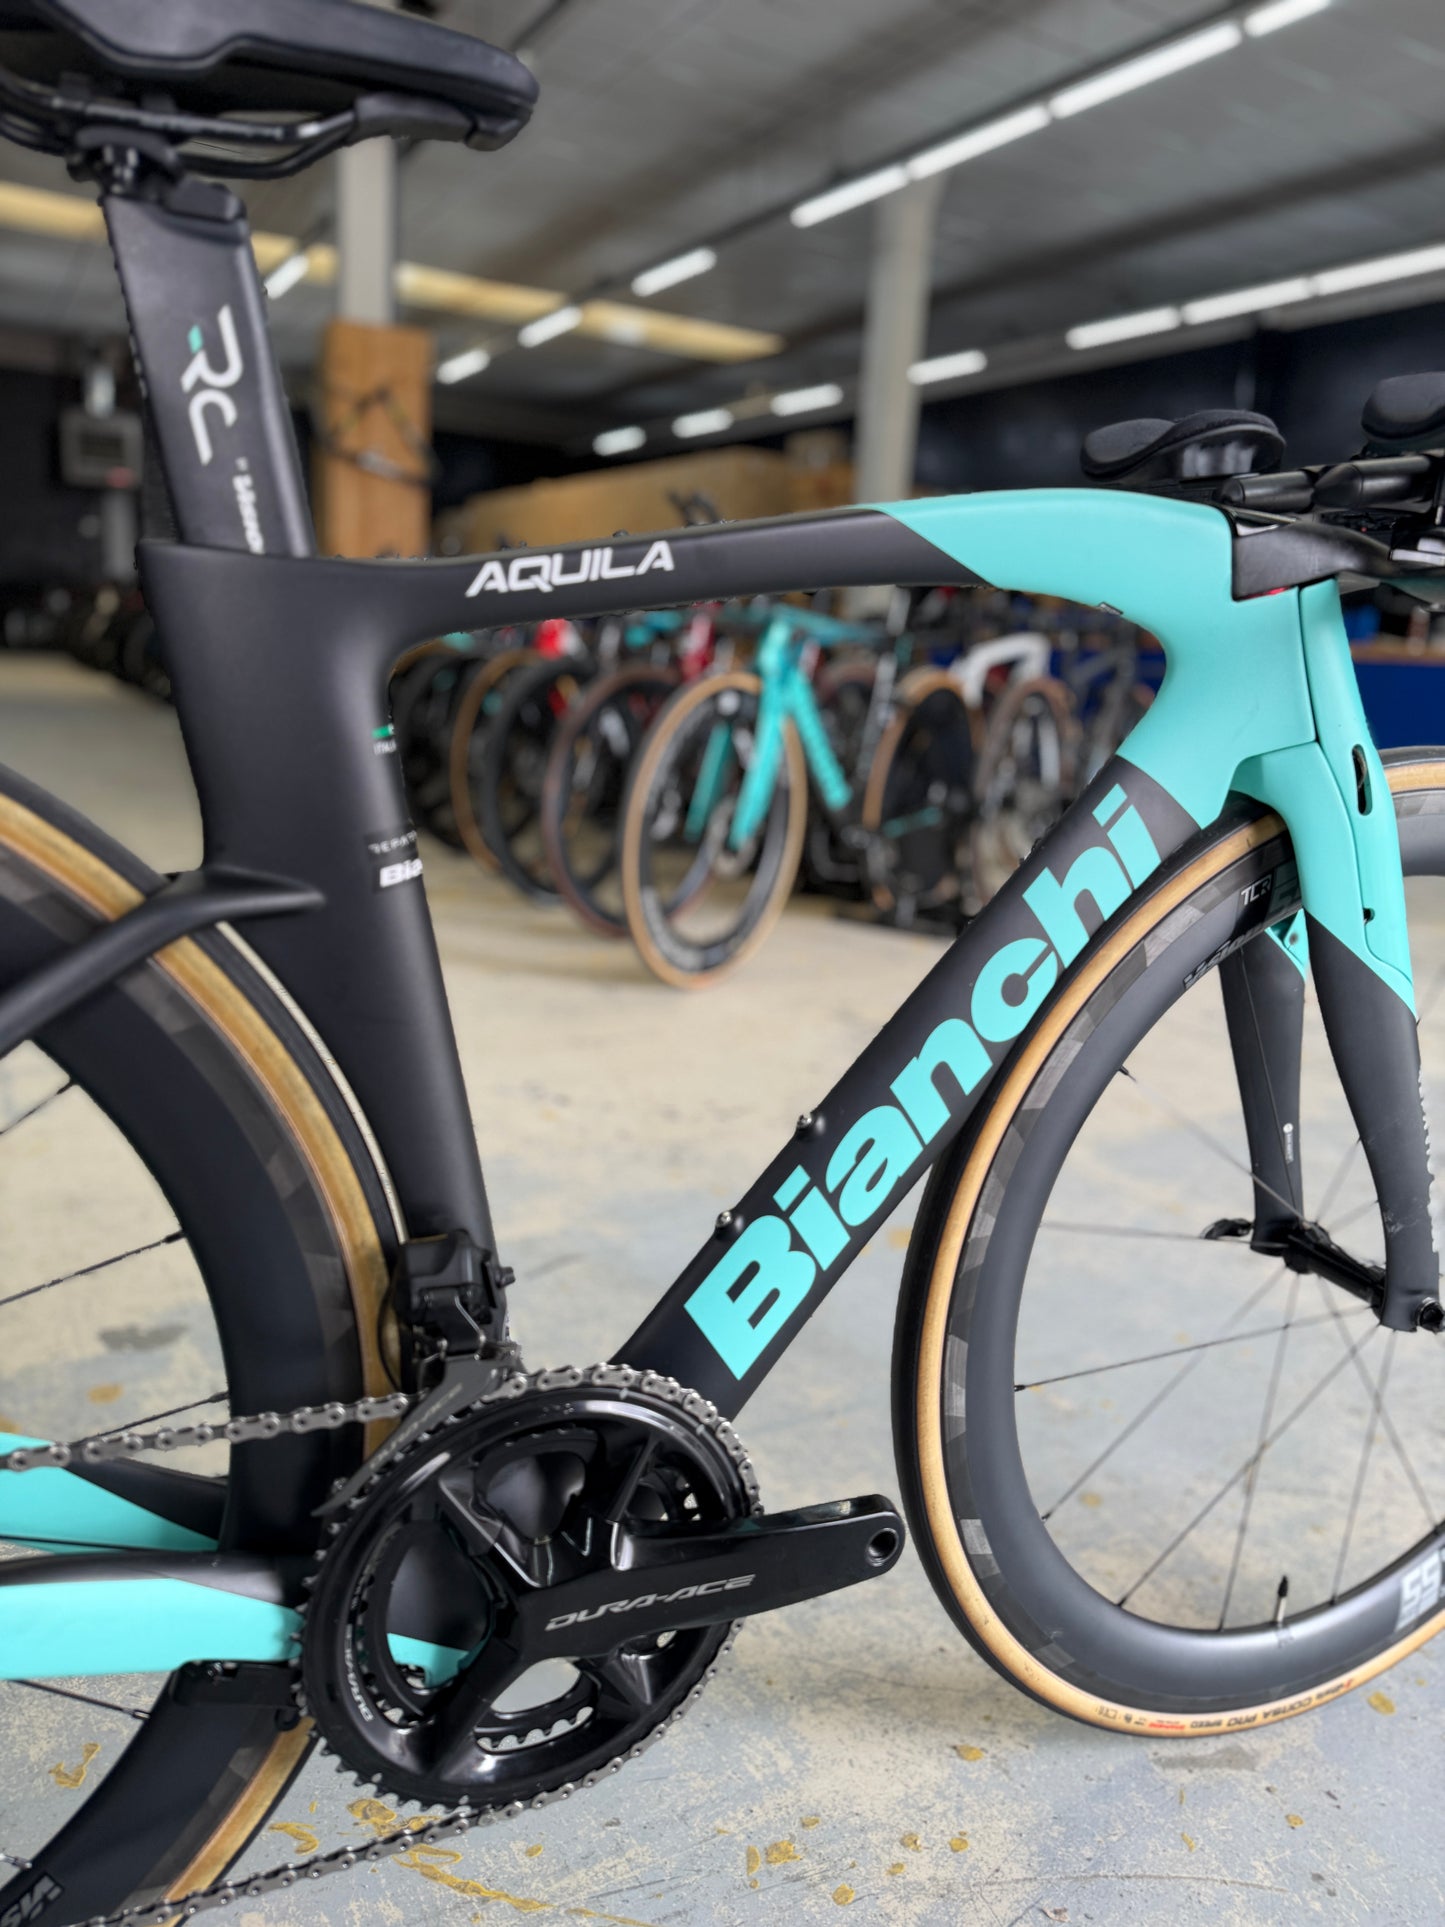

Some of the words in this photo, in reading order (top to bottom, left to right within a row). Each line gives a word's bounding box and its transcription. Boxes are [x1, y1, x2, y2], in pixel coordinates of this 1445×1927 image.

[180, 304, 244, 467] RC
[464, 540, 675, 598] AQUILA
[683, 783, 1162, 1381] Bianchi
[544, 1573, 756, 1632] DURA-ACE
